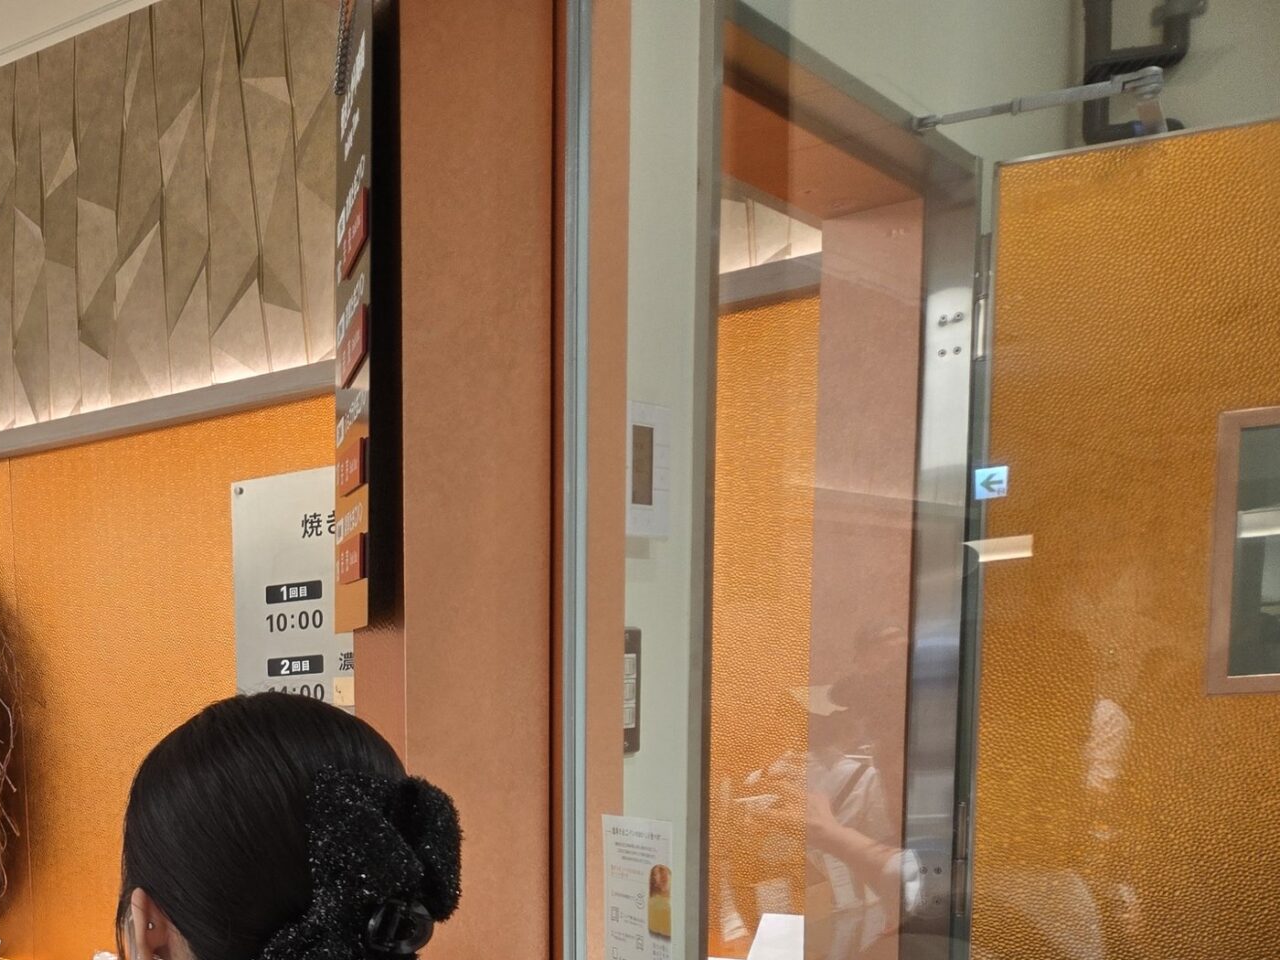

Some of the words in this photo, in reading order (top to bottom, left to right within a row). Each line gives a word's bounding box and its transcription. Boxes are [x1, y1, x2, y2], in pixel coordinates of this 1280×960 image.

[280, 586, 307, 601] 1回目
[266, 609, 324, 633] 10:00
[280, 659, 310, 675] 2回目
